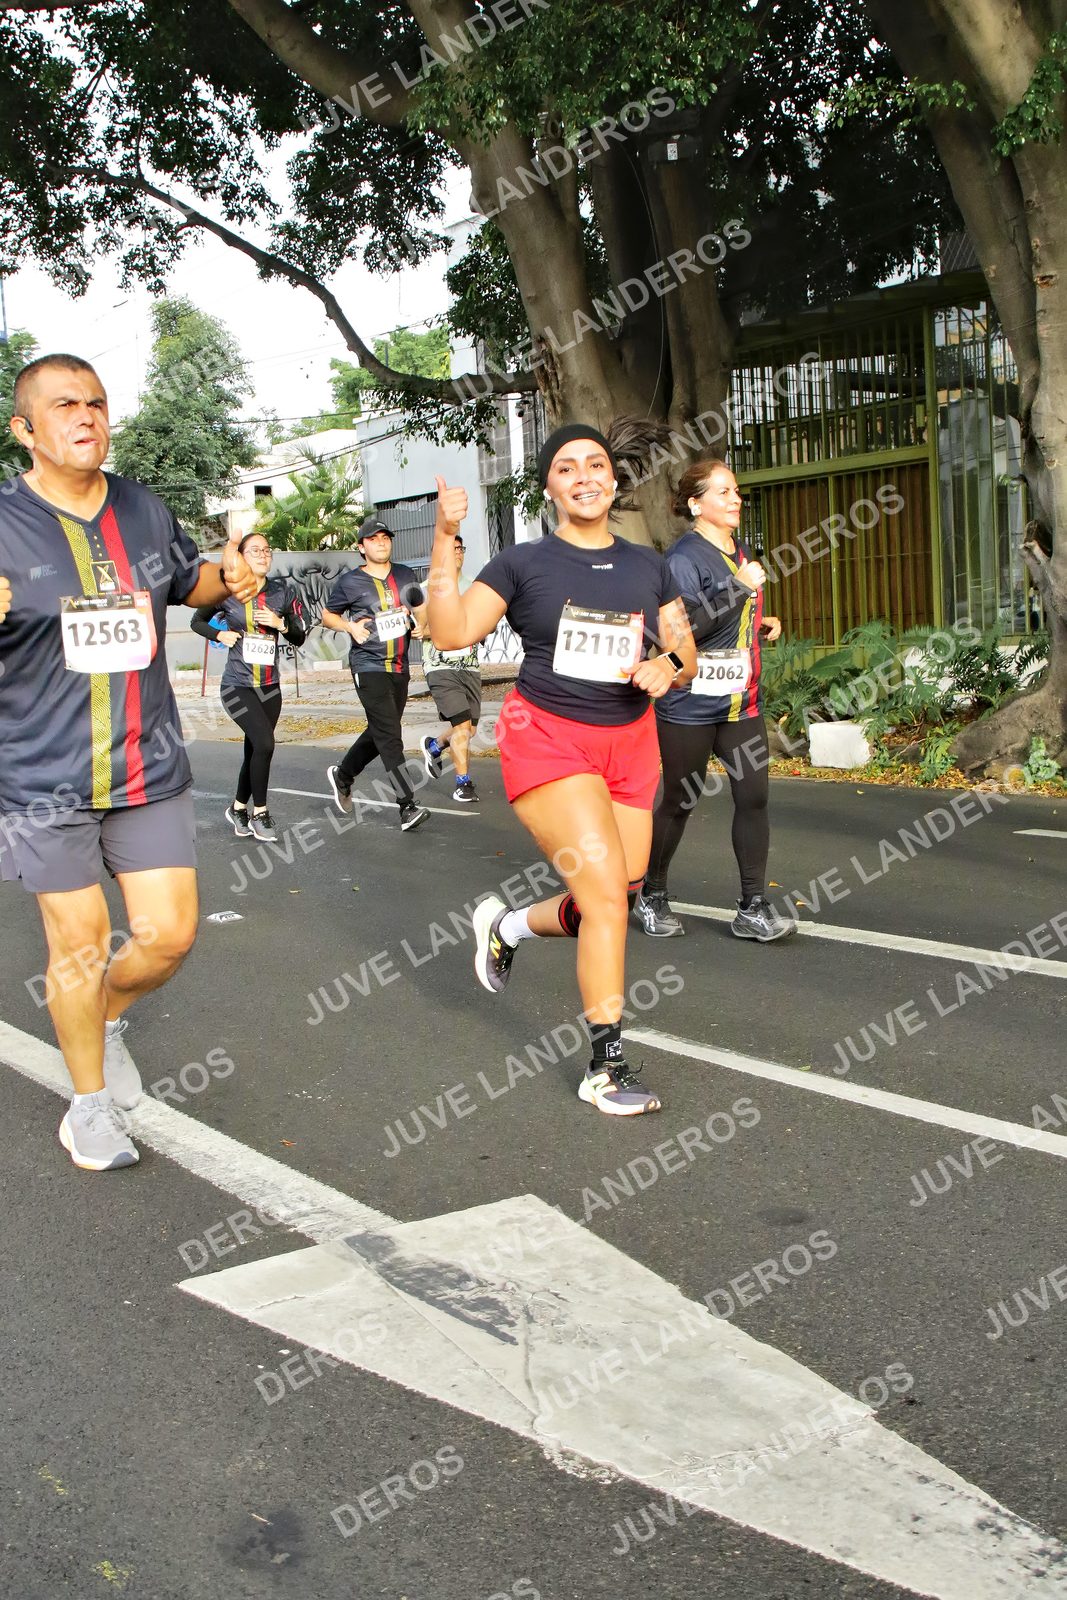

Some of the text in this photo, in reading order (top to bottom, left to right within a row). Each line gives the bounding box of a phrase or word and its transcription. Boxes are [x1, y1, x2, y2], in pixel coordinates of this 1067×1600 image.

[378, 616, 406, 631] 10541
[67, 619, 142, 647] 12563
[245, 642, 275, 655] 12628
[562, 630, 631, 658] 12118
[698, 664, 744, 681] 12062
